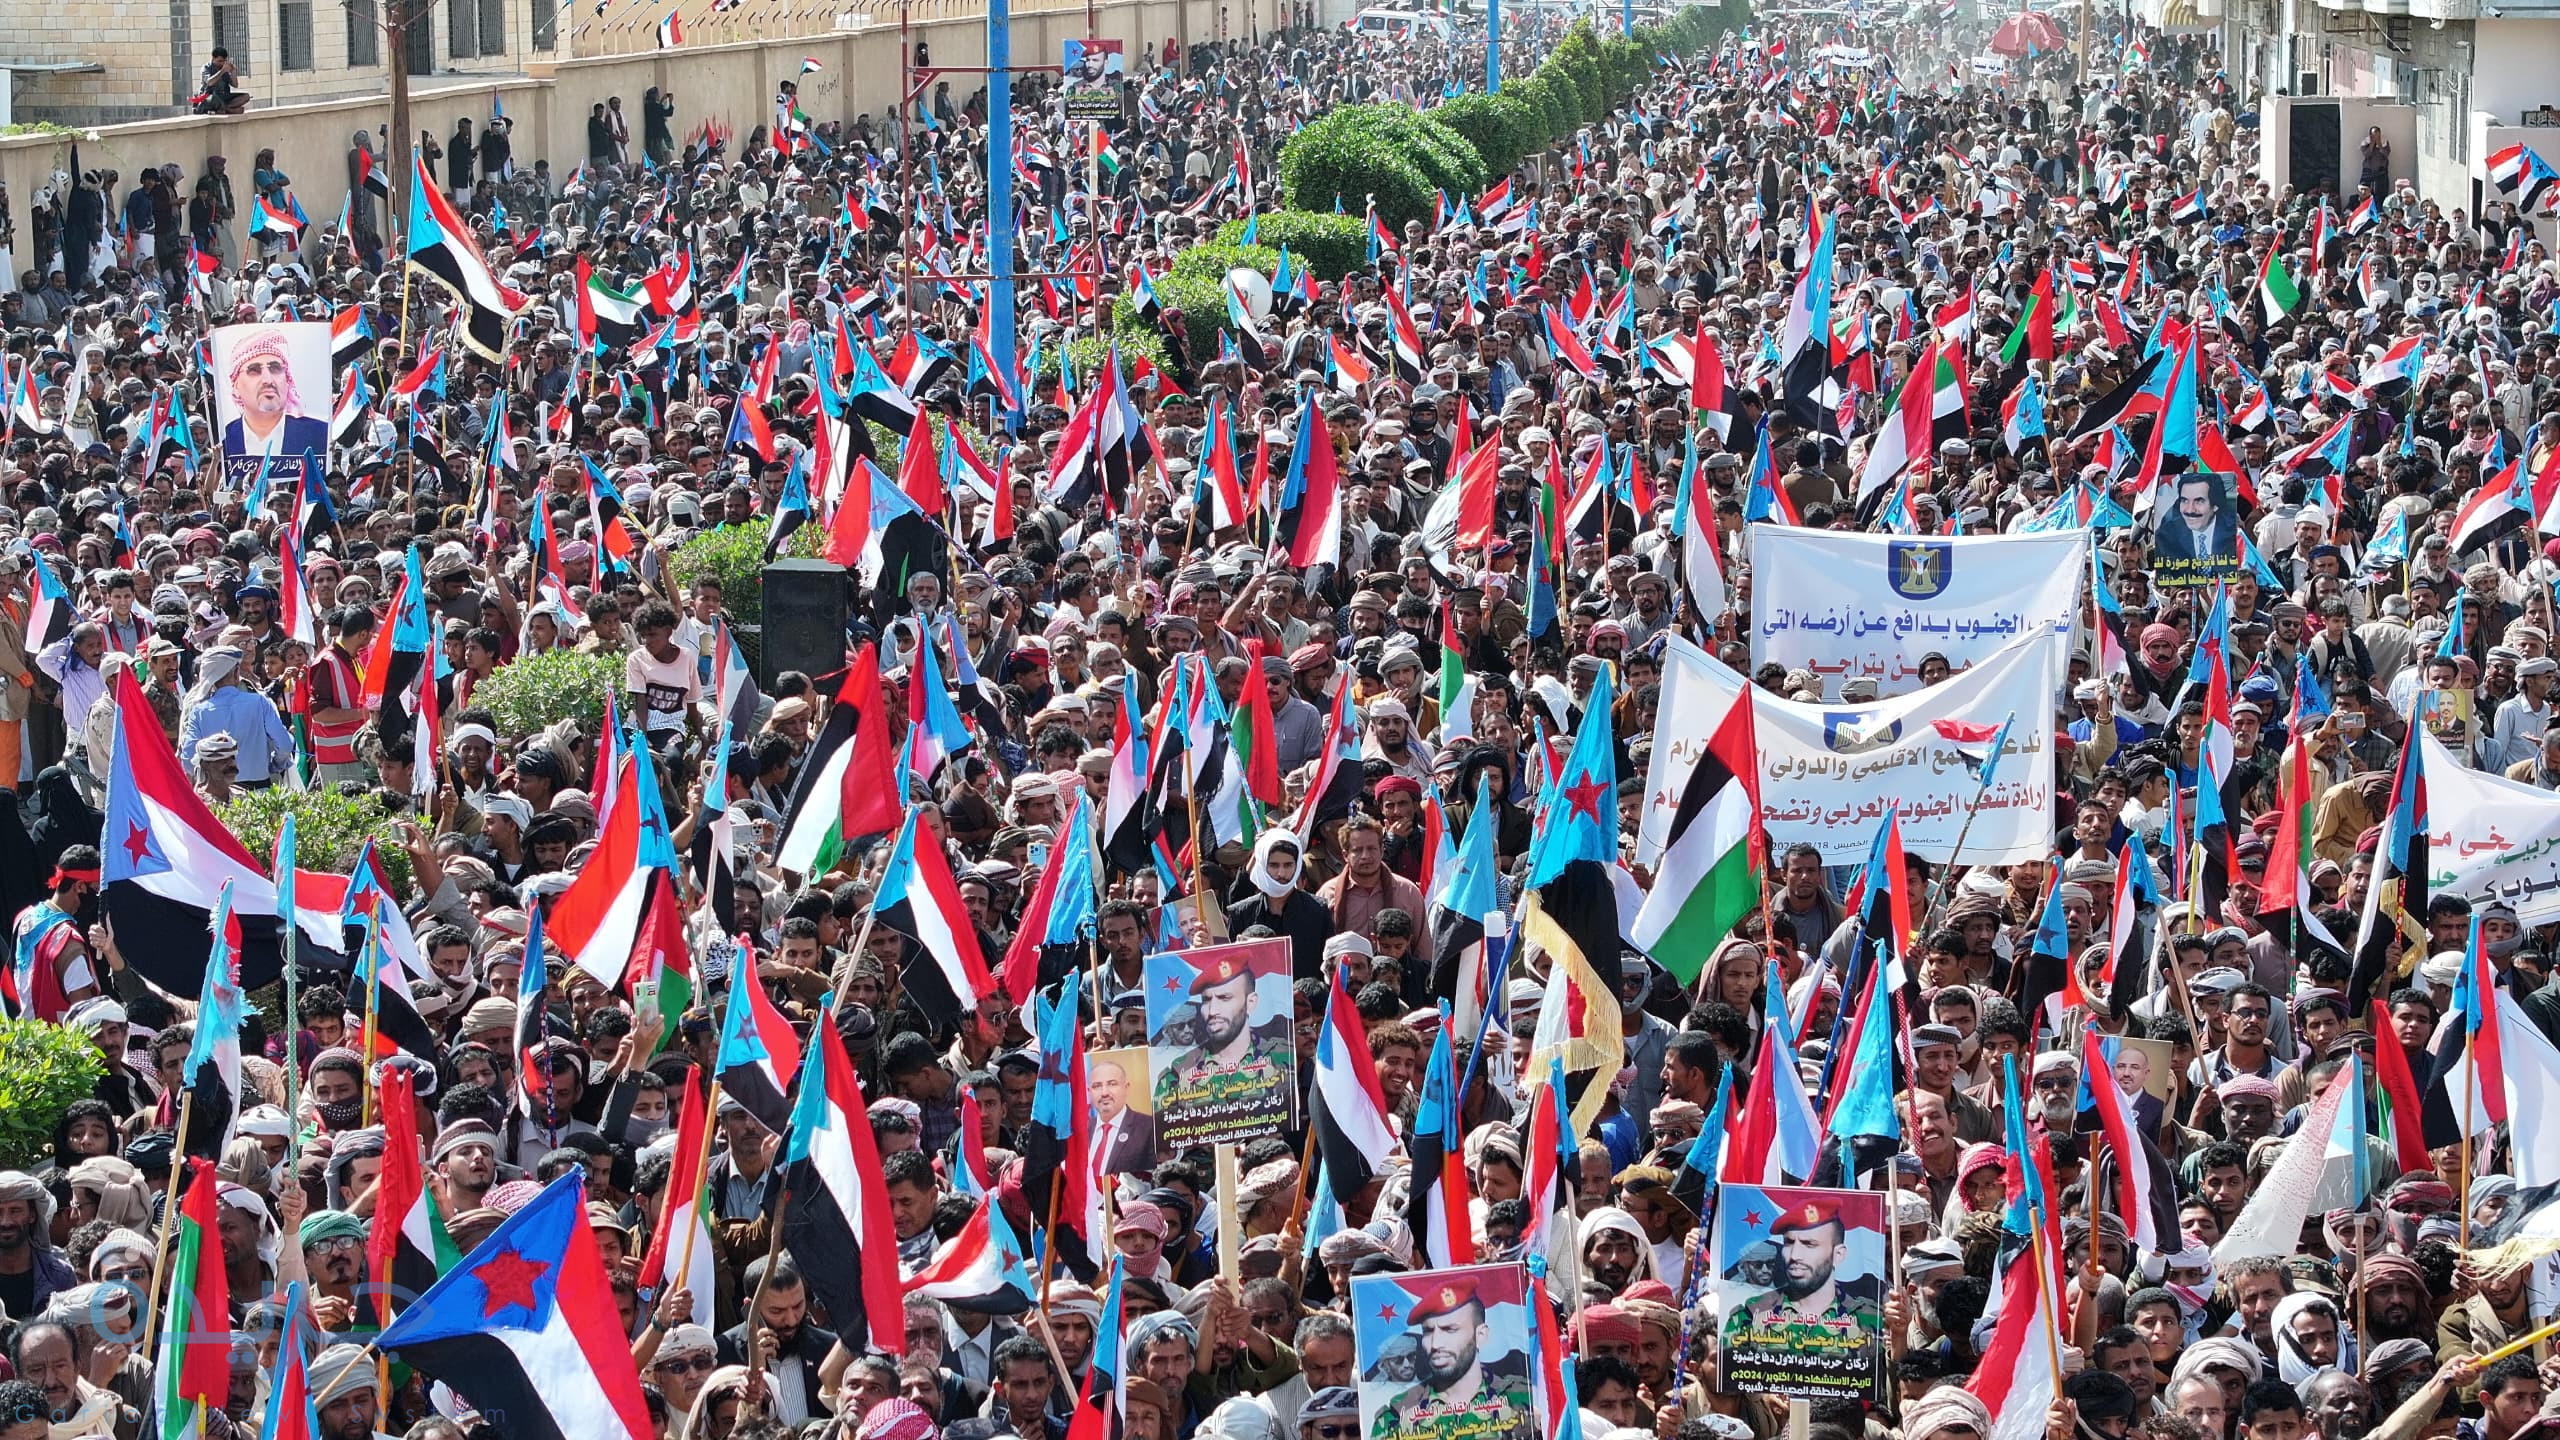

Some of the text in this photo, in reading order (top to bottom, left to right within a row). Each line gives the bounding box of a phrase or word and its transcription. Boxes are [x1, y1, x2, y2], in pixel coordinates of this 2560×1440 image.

[2165, 556, 2189, 571] صورة
[1763, 607, 1795, 639] التي
[1800, 604, 1850, 638] أرضه
[1853, 610, 1888, 638] عن
[1893, 611, 1950, 640] يدافع
[1956, 610, 2023, 640] الجنوب
[1998, 729, 2041, 757] ندع
[1769, 755, 1848, 782] والدولي
[1851, 745, 1926, 782] الاقليمي
[2011, 781, 2046, 812] إرادة
[1823, 795, 1891, 830] العربي
[1898, 792, 1959, 826] الجنوب
[1833, 839, 1868, 850] الخميس
[1215, 1061, 1240, 1076] القائد
[1243, 1056, 1272, 1072] الشهيد
[1219, 1077, 1255, 1099] محسن
[1161, 1083, 1216, 1110] السليماني
[1242, 1100, 1262, 1112] حرب
[1163, 1109, 1184, 1125] شبوة
[1184, 1108, 1202, 1122] دفاع
[1228, 1114, 1269, 1130] الاستشهاد
[1269, 1110, 1288, 1125] تاريخ
[1233, 1127, 1262, 1140] منطقة
[1262, 1126, 1278, 1138] في
[1170, 1135, 1194, 1150] شبوة
[1793, 1312, 1820, 1326] القائد
[1823, 1311, 1857, 1329] الشهيد
[1731, 1326, 1871, 1350] أحمد محسن السليماني
[1732, 1350, 1755, 1364] شبوة
[1754, 1351, 1775, 1364] دفاع
[1797, 1356, 1821, 1368] اللواء
[1822, 1358, 1843, 1370] حرب
[1845, 1356, 1869, 1371] أركان
[1738, 1381, 1764, 1393] شبوة
[1804, 1374, 1850, 1386] الاستشهاد
[1850, 1376, 1872, 1389] تاريخ
[1809, 1387, 1841, 1397] منطقة
[1842, 1387, 1860, 1400] في
[1442, 1400, 1471, 1416] القائد
[1474, 1394, 1509, 1413] الشهيد
[1409, 1404, 1439, 1423] البطل
[1490, 1410, 1525, 1432] أحمد
[1446, 1419, 1487, 1440] محسن
